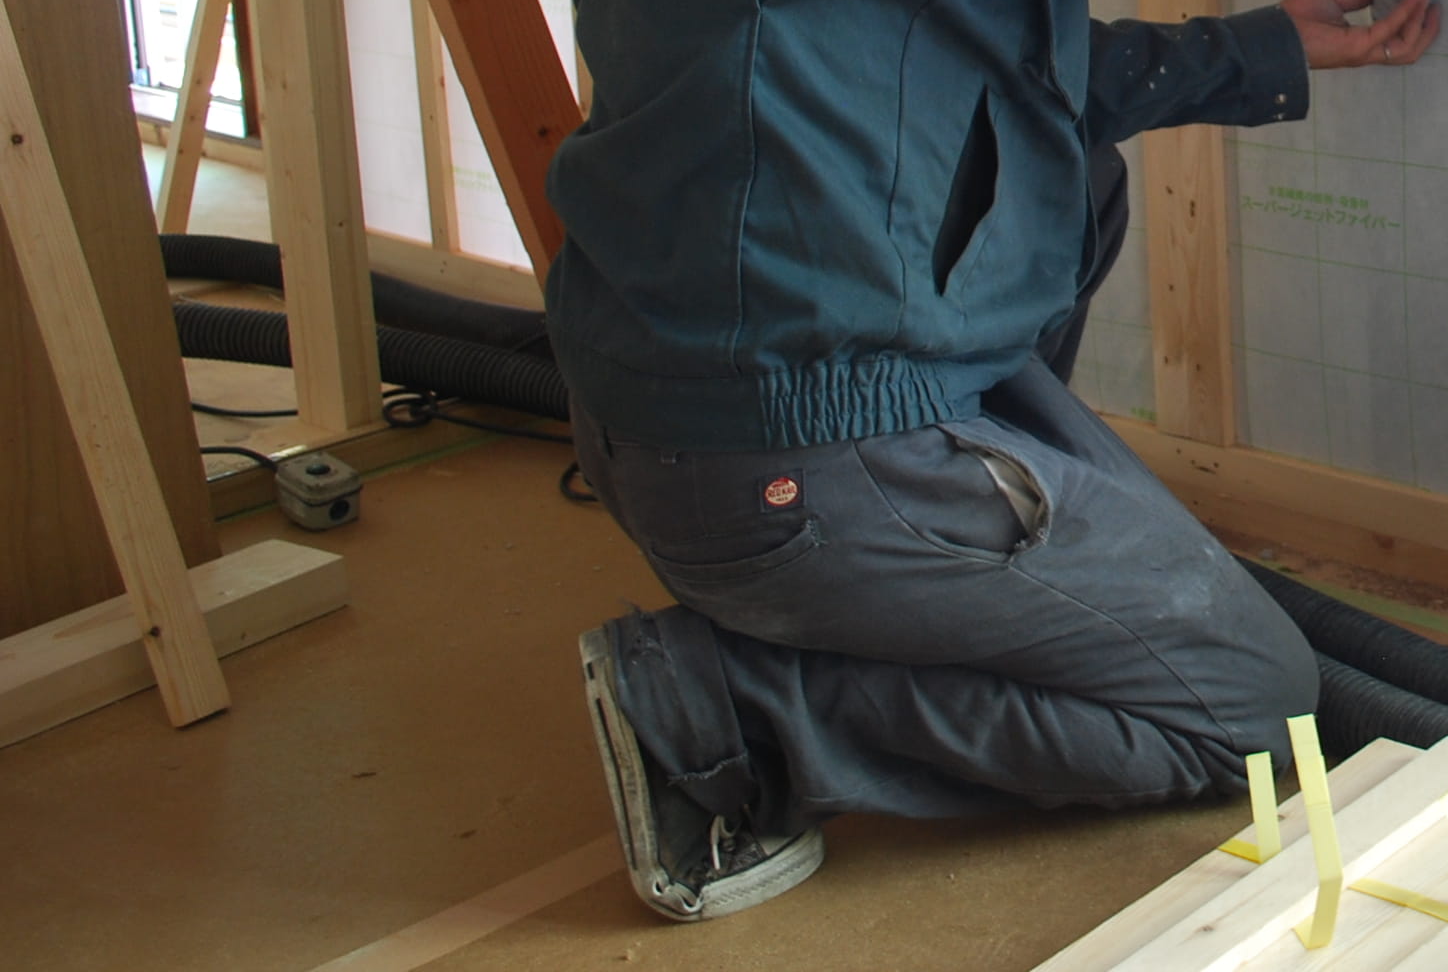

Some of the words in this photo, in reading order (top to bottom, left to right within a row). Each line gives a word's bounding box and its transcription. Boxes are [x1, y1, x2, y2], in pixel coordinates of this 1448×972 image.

[1240, 194, 1401, 229] スーパージェットファイバー
